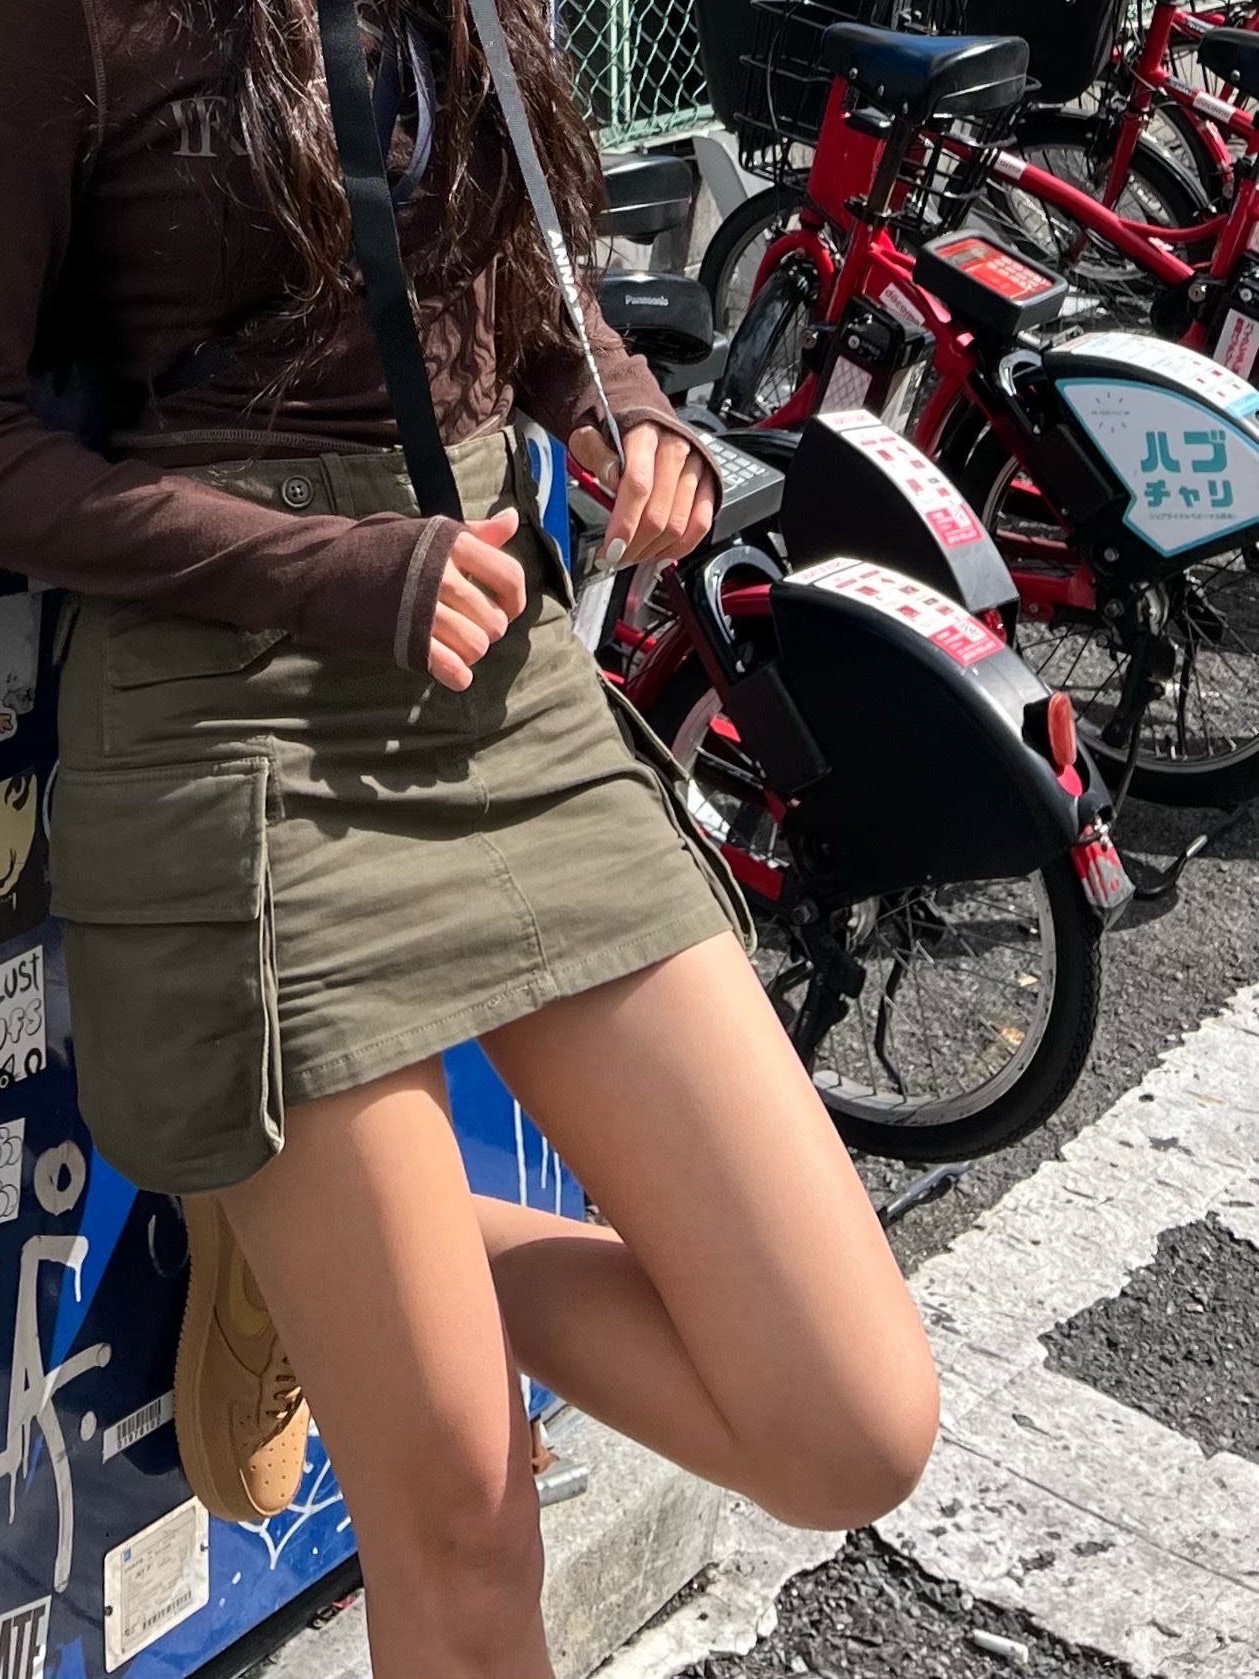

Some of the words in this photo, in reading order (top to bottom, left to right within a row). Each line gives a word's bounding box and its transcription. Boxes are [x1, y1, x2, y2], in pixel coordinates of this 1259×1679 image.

[1140, 429, 1228, 473] ハブ
[1144, 479, 1234, 508] チャリ
